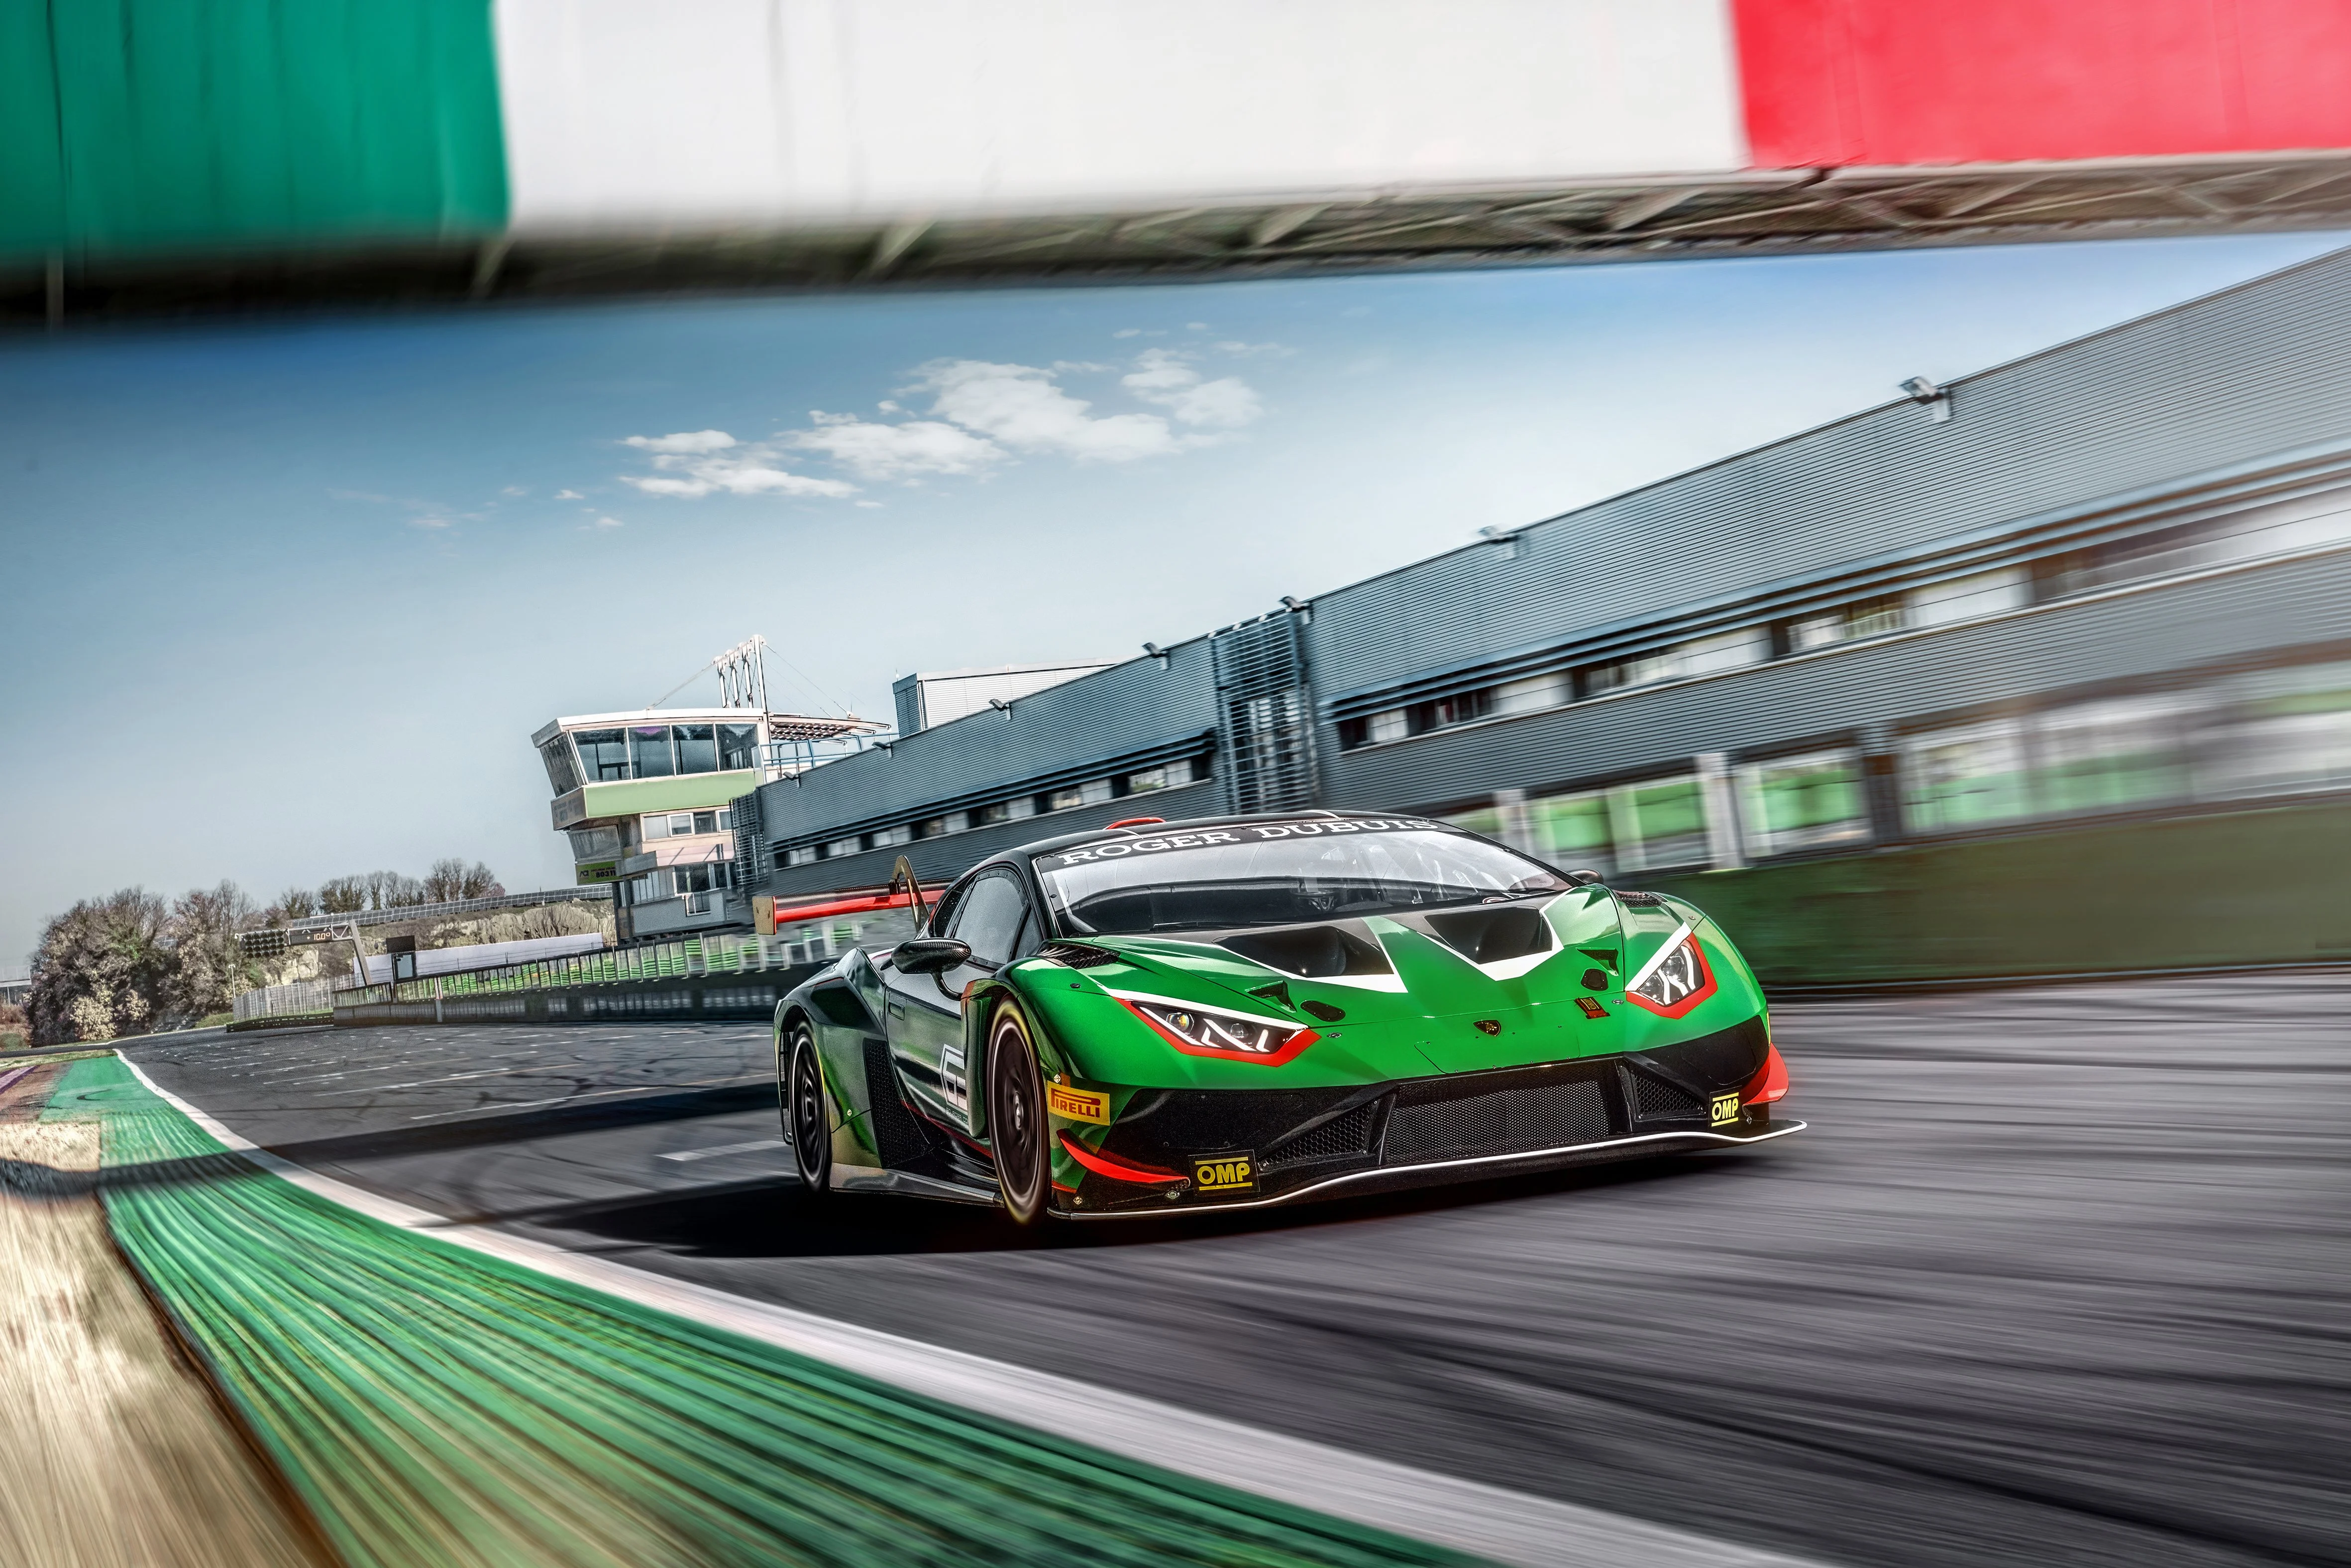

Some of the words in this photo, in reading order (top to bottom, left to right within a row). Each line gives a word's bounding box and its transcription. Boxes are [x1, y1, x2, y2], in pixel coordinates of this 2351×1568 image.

[1058, 832, 1241, 865] ROGER
[1251, 819, 1439, 838] DUBUIS
[1051, 1087, 1101, 1118] PIRELLI
[1711, 1097, 1739, 1121] OMP
[1197, 1162, 1250, 1184] OMP
